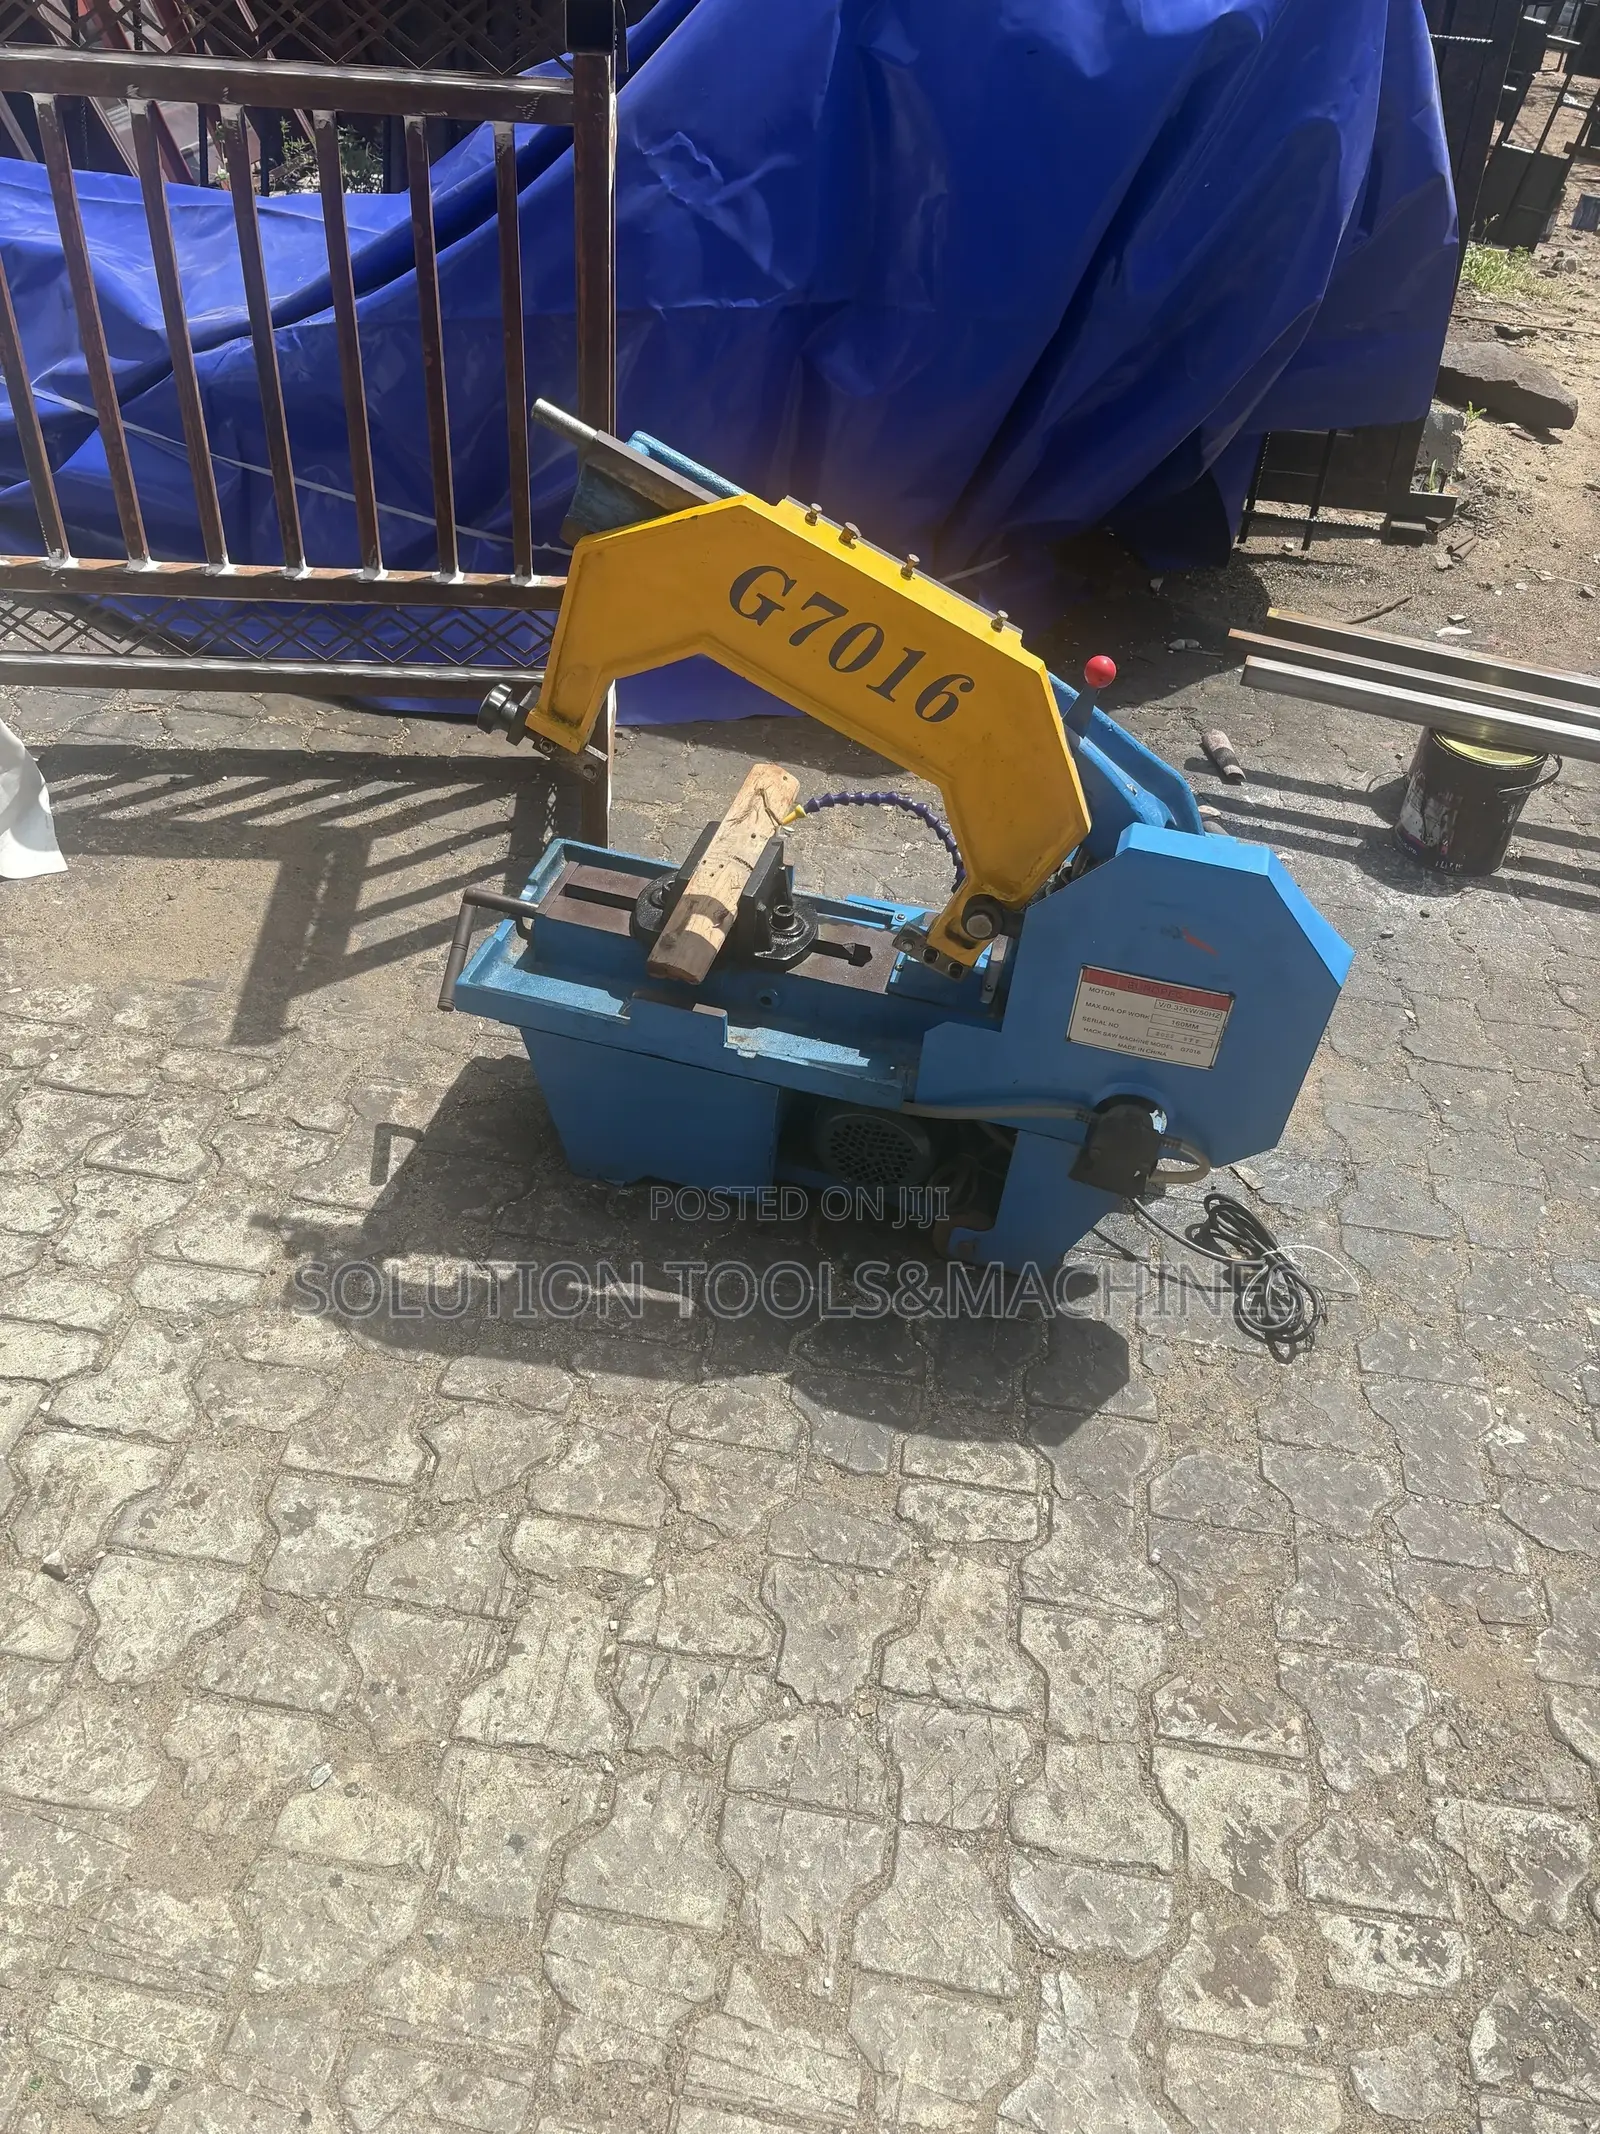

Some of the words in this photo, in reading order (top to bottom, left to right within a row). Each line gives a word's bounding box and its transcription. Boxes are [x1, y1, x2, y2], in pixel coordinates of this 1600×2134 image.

[729, 565, 975, 723] G7016
[1089, 986, 1116, 997] MOTOR
[1158, 1002, 1221, 1019] V/0.37KW/50HZ
[1082, 1016, 1107, 1026] SERIAL
[1128, 1011, 1150, 1020] WORK
[1172, 1020, 1199, 1030] 160MM
[1083, 1027, 1102, 1035] HACK
[1103, 1031, 1118, 1039] SAW
[1119, 1035, 1149, 1045] MACHINE
[1150, 1042, 1174, 1050] MODEL
[1180, 1046, 1201, 1056] G7016
[1117, 1043, 1137, 1051] MADE
[1146, 1048, 1167, 1057] CHINA
